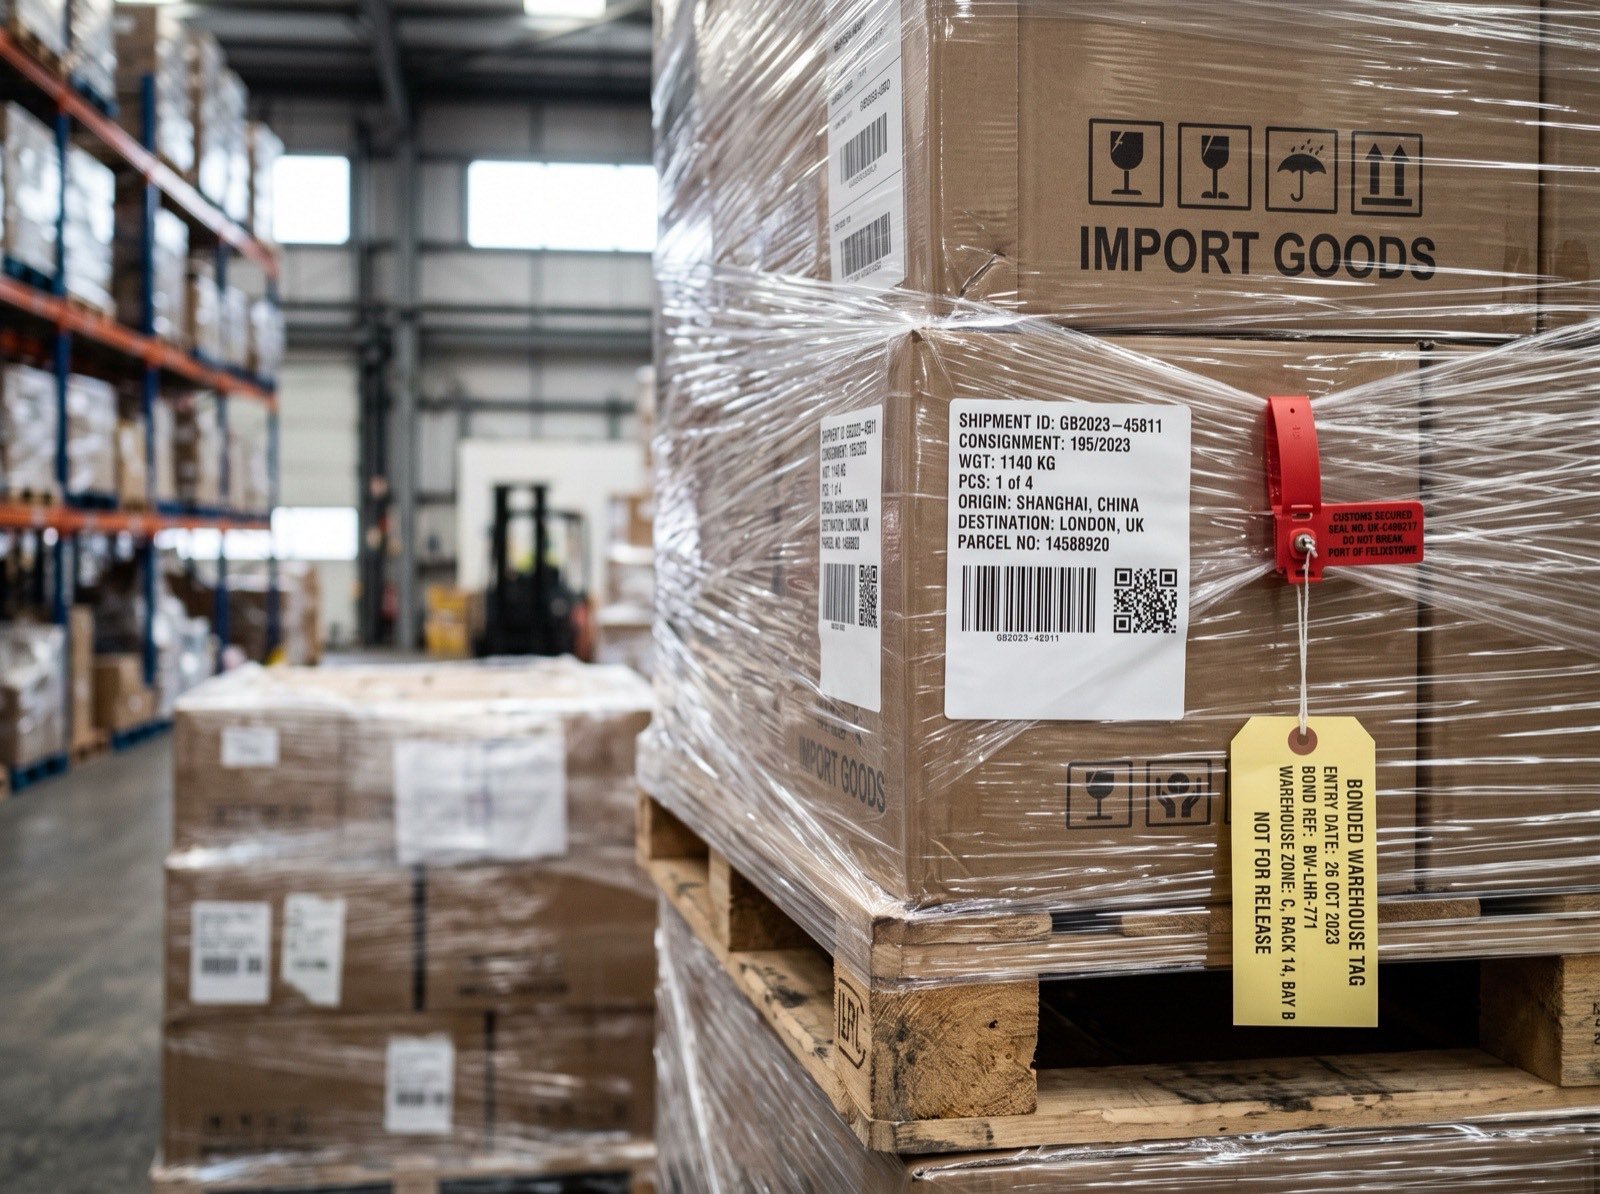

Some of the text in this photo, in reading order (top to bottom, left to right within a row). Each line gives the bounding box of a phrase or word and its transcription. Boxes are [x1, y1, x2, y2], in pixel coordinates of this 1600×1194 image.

[1080, 225, 1436, 281] IMPORT GOODS
[959, 413, 1162, 433] SHIPMENT ID: GB2023-45811
[959, 434, 1131, 452] CONSIGNMENT: 195/2023
[959, 454, 1056, 471] WGT: 1140 KG
[959, 474, 1033, 490] PCS: 1 of 4
[958, 494, 1139, 513] ORIGIN: SHANGHAI, CHINA
[958, 514, 1145, 534] DESTINATION: LONDON, UK
[1333, 510, 1413, 522] CUSTOMS SECURED
[1328, 524, 1349, 534] SEAL
[1351, 523, 1365, 533] NO.
[958, 534, 1109, 552] PARCEL NO: 14588920
[1343, 534, 1404, 545] DO NOT BREAK
[1328, 545, 1418, 557] PORT OF FELIXSTOWE
[841, 755, 886, 813] GOODS
[1302, 766, 1318, 929] BOND REF: BW-LHR-771
[1323, 766, 1340, 945] ENTRY DATE: 26 OCT 2023
[1254, 812, 1271, 954] NOT FOR RELEASE
[1347, 779, 1366, 986] BONDED WAREHOUSE TAG
[1279, 765, 1296, 1020] WAREHOUSE ZONE: C, RACK 14, BAY B
